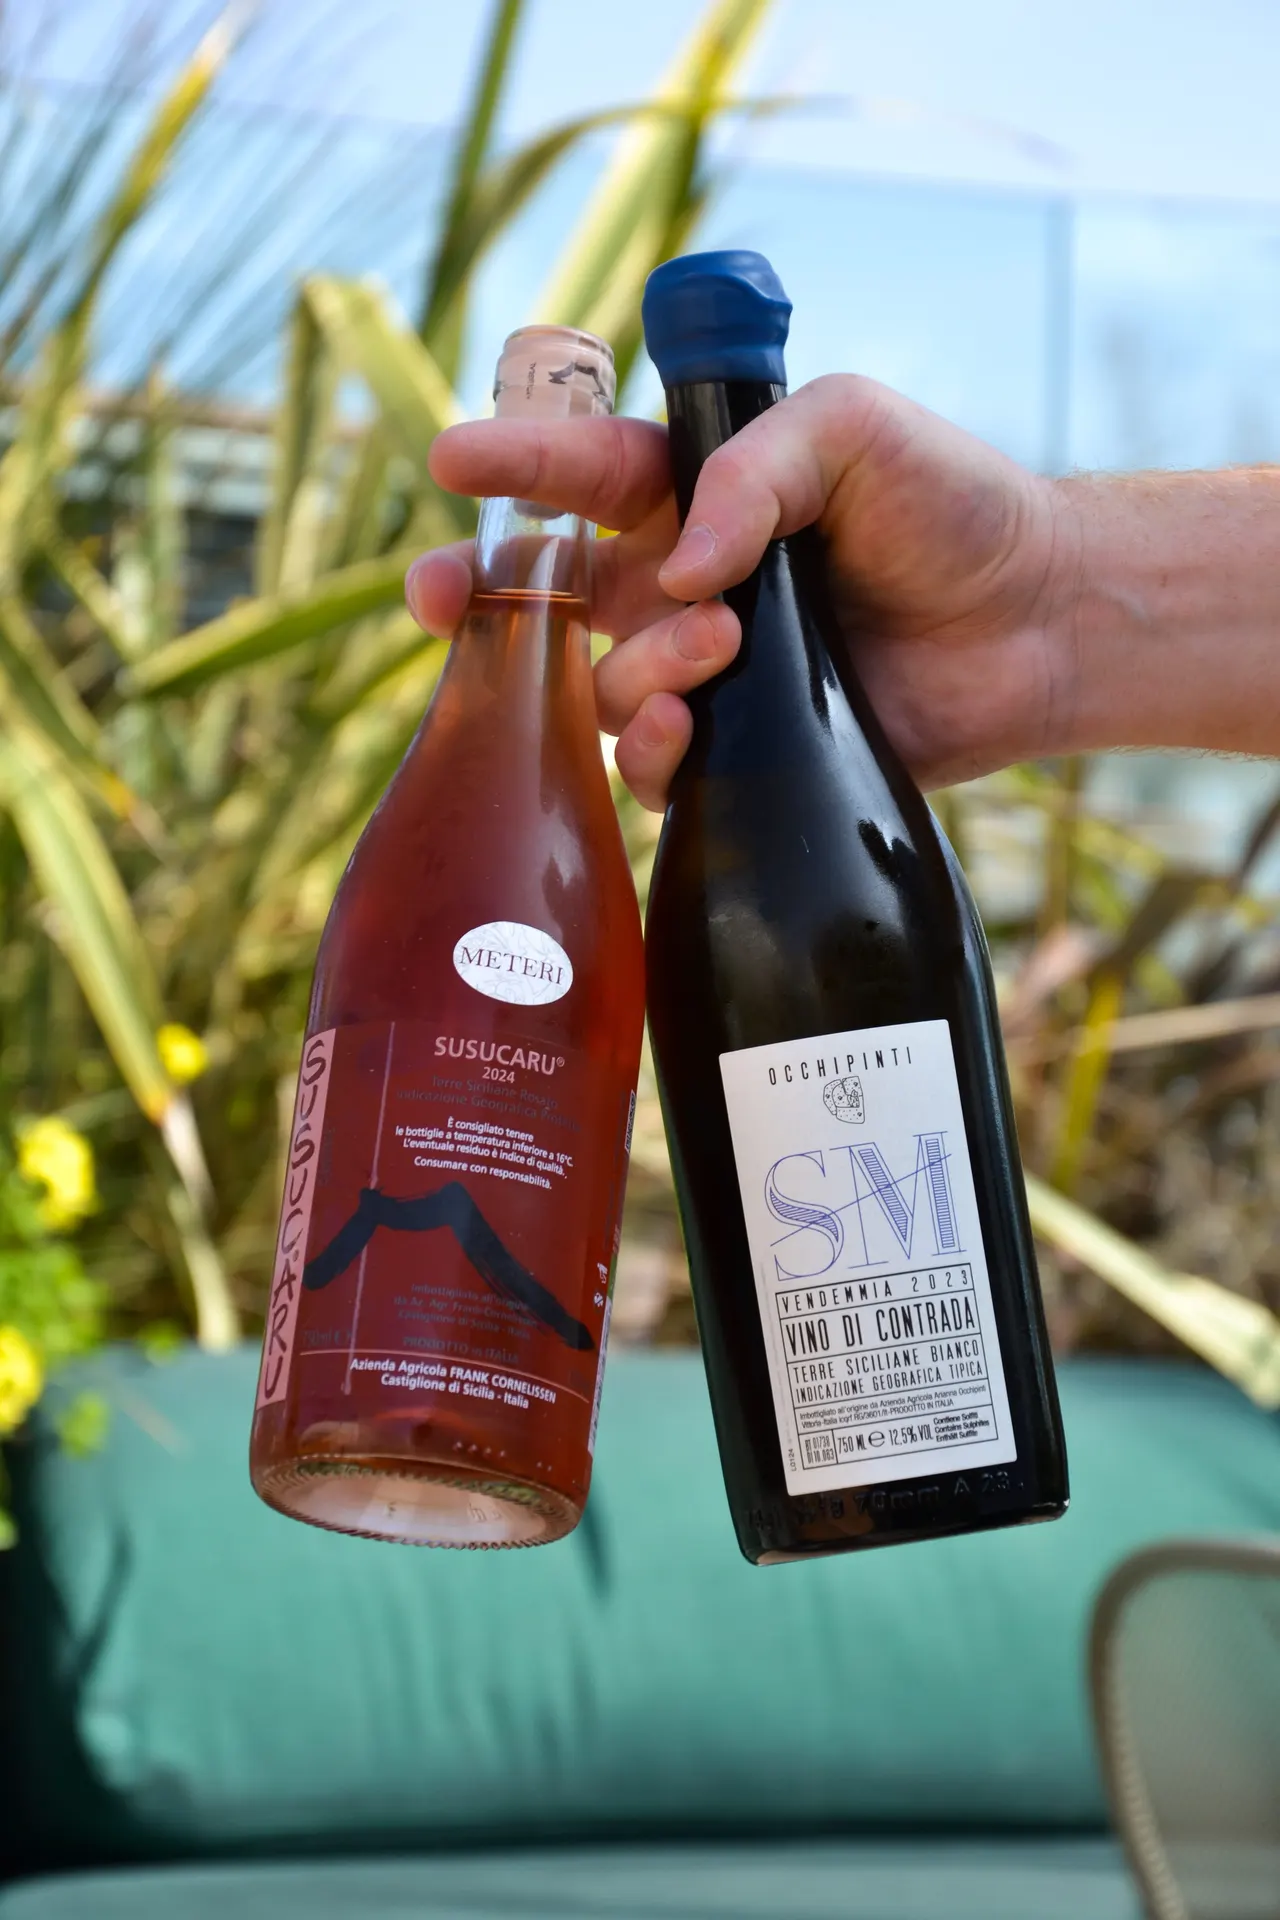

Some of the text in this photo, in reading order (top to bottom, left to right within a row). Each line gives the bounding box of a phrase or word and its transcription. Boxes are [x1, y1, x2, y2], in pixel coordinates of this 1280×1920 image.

[459, 946, 566, 985] METERI
[482, 1066, 515, 1084] 2024
[768, 1046, 913, 1086] OCCHIPINTI
[395, 1126, 404, 1136] le
[405, 1126, 445, 1140] bottiglie
[445, 1131, 452, 1139] a
[454, 1129, 511, 1149] temperatura
[512, 1140, 548, 1158] inferiore
[549, 1152, 555, 1160] a
[455, 1119, 504, 1136] consigliato
[506, 1128, 534, 1142] tenere
[456, 1144, 490, 1157] residuo
[491, 1147, 498, 1158] è
[499, 1149, 526, 1164] indice
[526, 1156, 536, 1166] di
[414, 1156, 552, 1190] Consumare con responsabilità.
[765, 1131, 966, 1281] SM
[781, 1269, 968, 1314] VENDEMMIA 2023
[785, 1296, 976, 1357] VINO DI CONTRADA
[793, 1339, 980, 1384] TERRE SICILIANE BIANCO
[350, 1357, 556, 1405] Azienda Agricola FRANK CORNELISSEN
[381, 1372, 446, 1392] Castiglione
[448, 1380, 460, 1394] di
[462, 1383, 495, 1401] Sicilia
[503, 1393, 530, 1409] Italia
[795, 1360, 984, 1404] INDICAZIONE GEOGRAFICA TIPICA
[800, 1407, 836, 1421] Imbottigliato
[870, 1401, 878, 1409] da
[880, 1396, 908, 1409] Azienda
[908, 1394, 933, 1407] Agricola
[934, 1391, 958, 1400] Arianna
[958, 1385, 987, 1396] Occhipinti
[926, 1401, 934, 1410] IN
[934, 1398, 954, 1409] ITALIA
[933, 1414, 961, 1426] Contiene
[812, 1435, 831, 1450] 01738
[837, 1435, 855, 1455] 750
[855, 1434, 868, 1452] ML
[917, 1424, 934, 1441] VOL
[934, 1419, 990, 1434] Contains Sulphites
